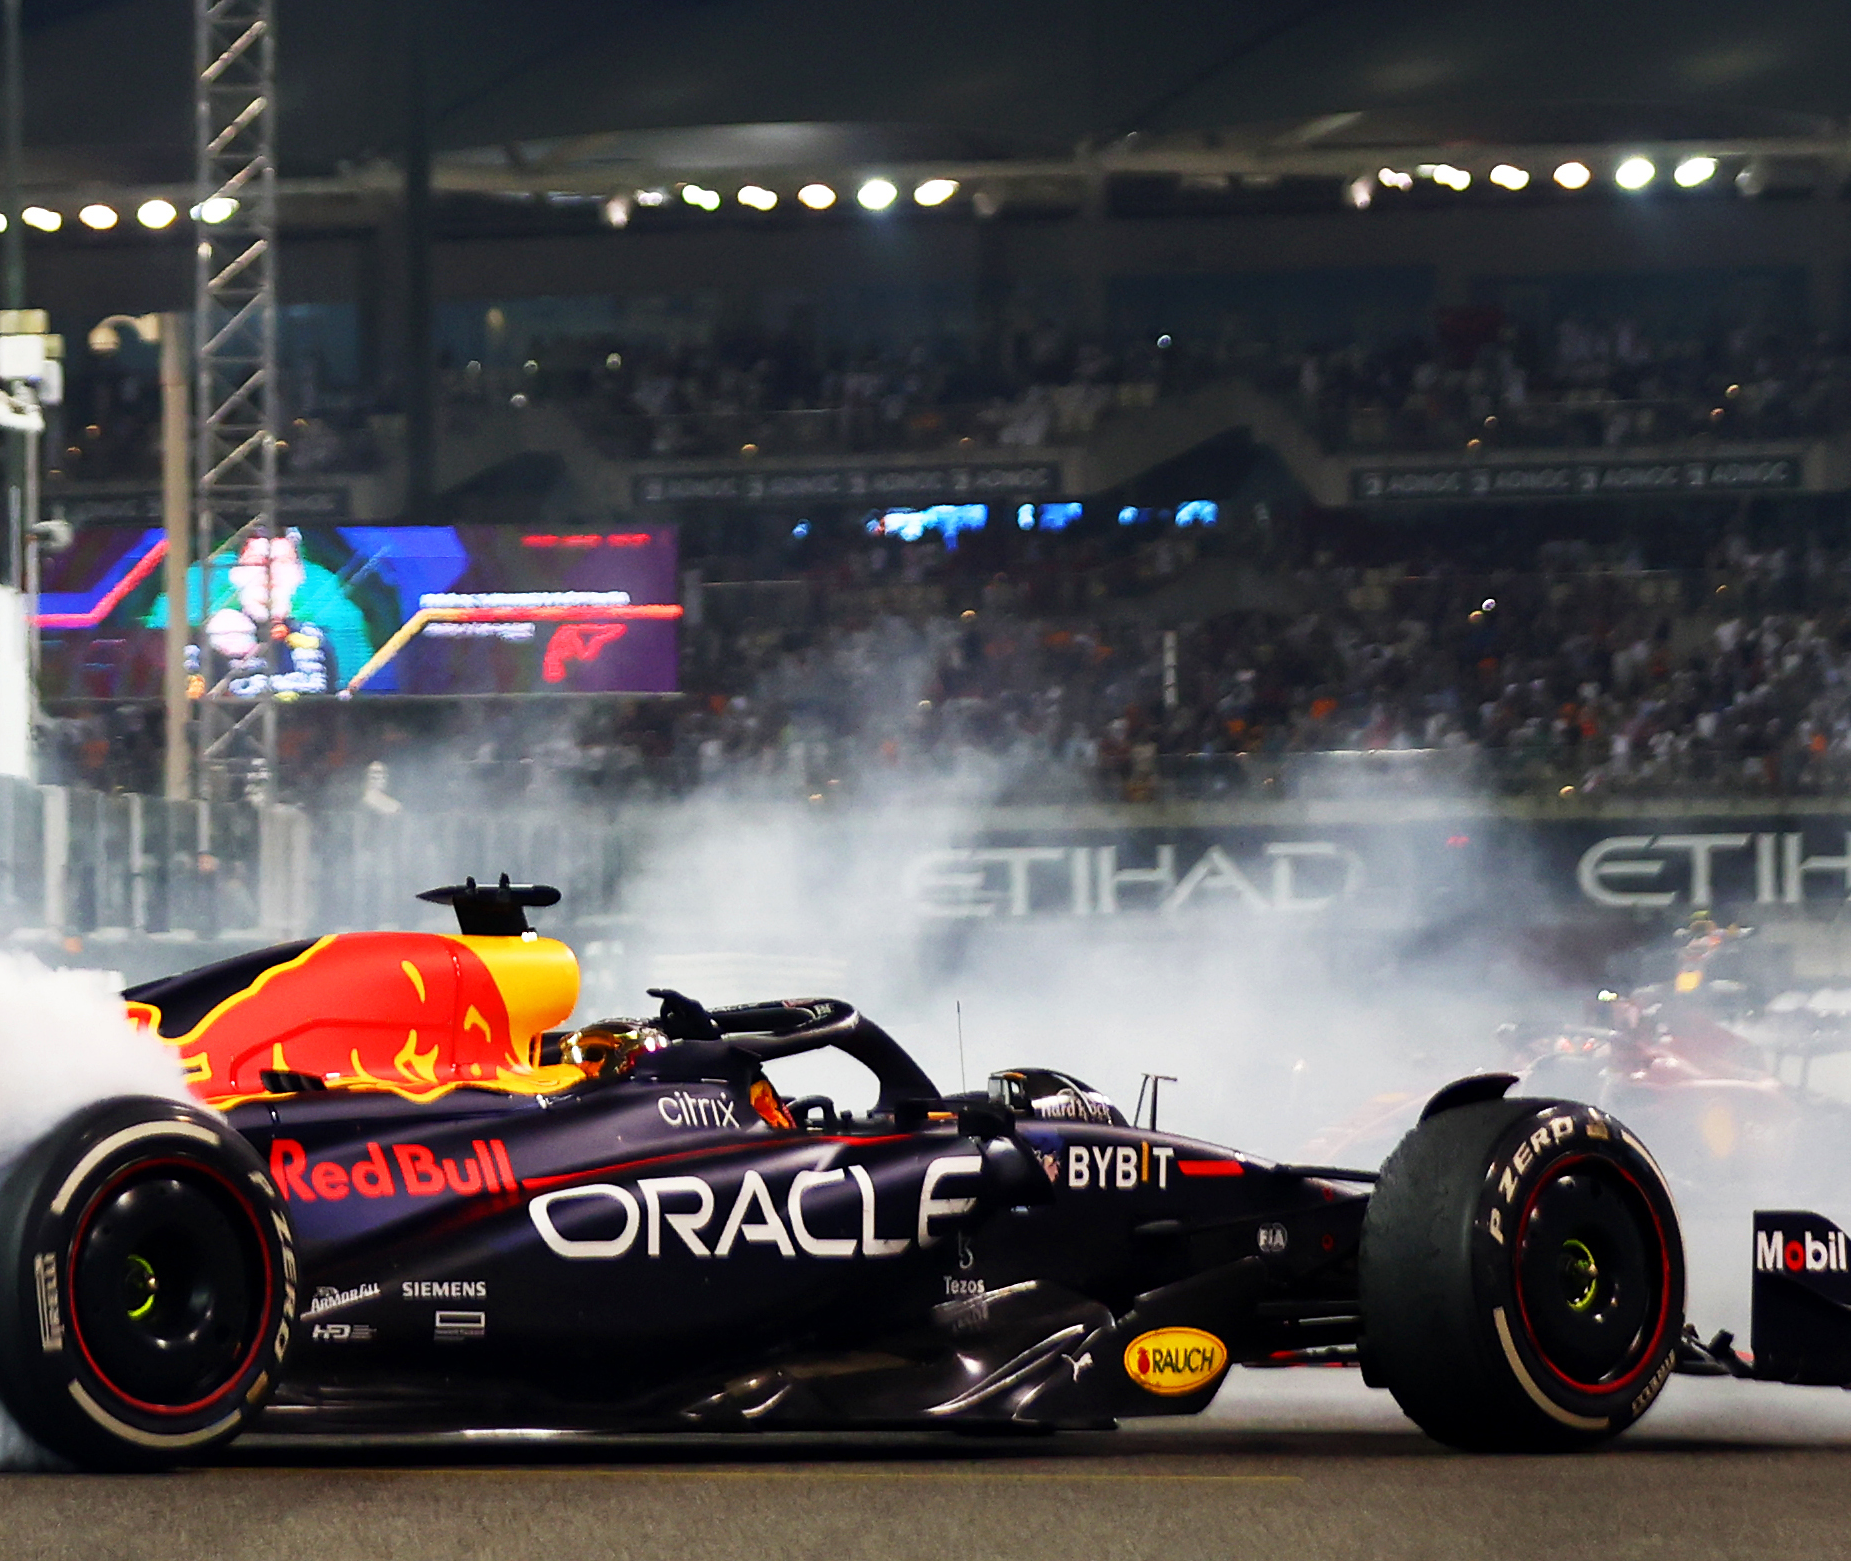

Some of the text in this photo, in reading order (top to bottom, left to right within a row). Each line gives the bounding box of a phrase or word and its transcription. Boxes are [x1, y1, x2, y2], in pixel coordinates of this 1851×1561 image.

[901, 841, 1365, 917] ETIHAD
[657, 1091, 741, 1129] citrix
[270, 1138, 521, 1203] Red Bull
[1069, 1141, 1175, 1190] BYBIT
[1498, 1115, 1575, 1204] ZERO
[529, 1155, 983, 1260] ORACLE
[1756, 1230, 1849, 1273] Mobil
[401, 1280, 488, 1298] SIEMENS
[943, 1275, 986, 1295] Tezos
[1152, 1347, 1215, 1374] RAUCH
